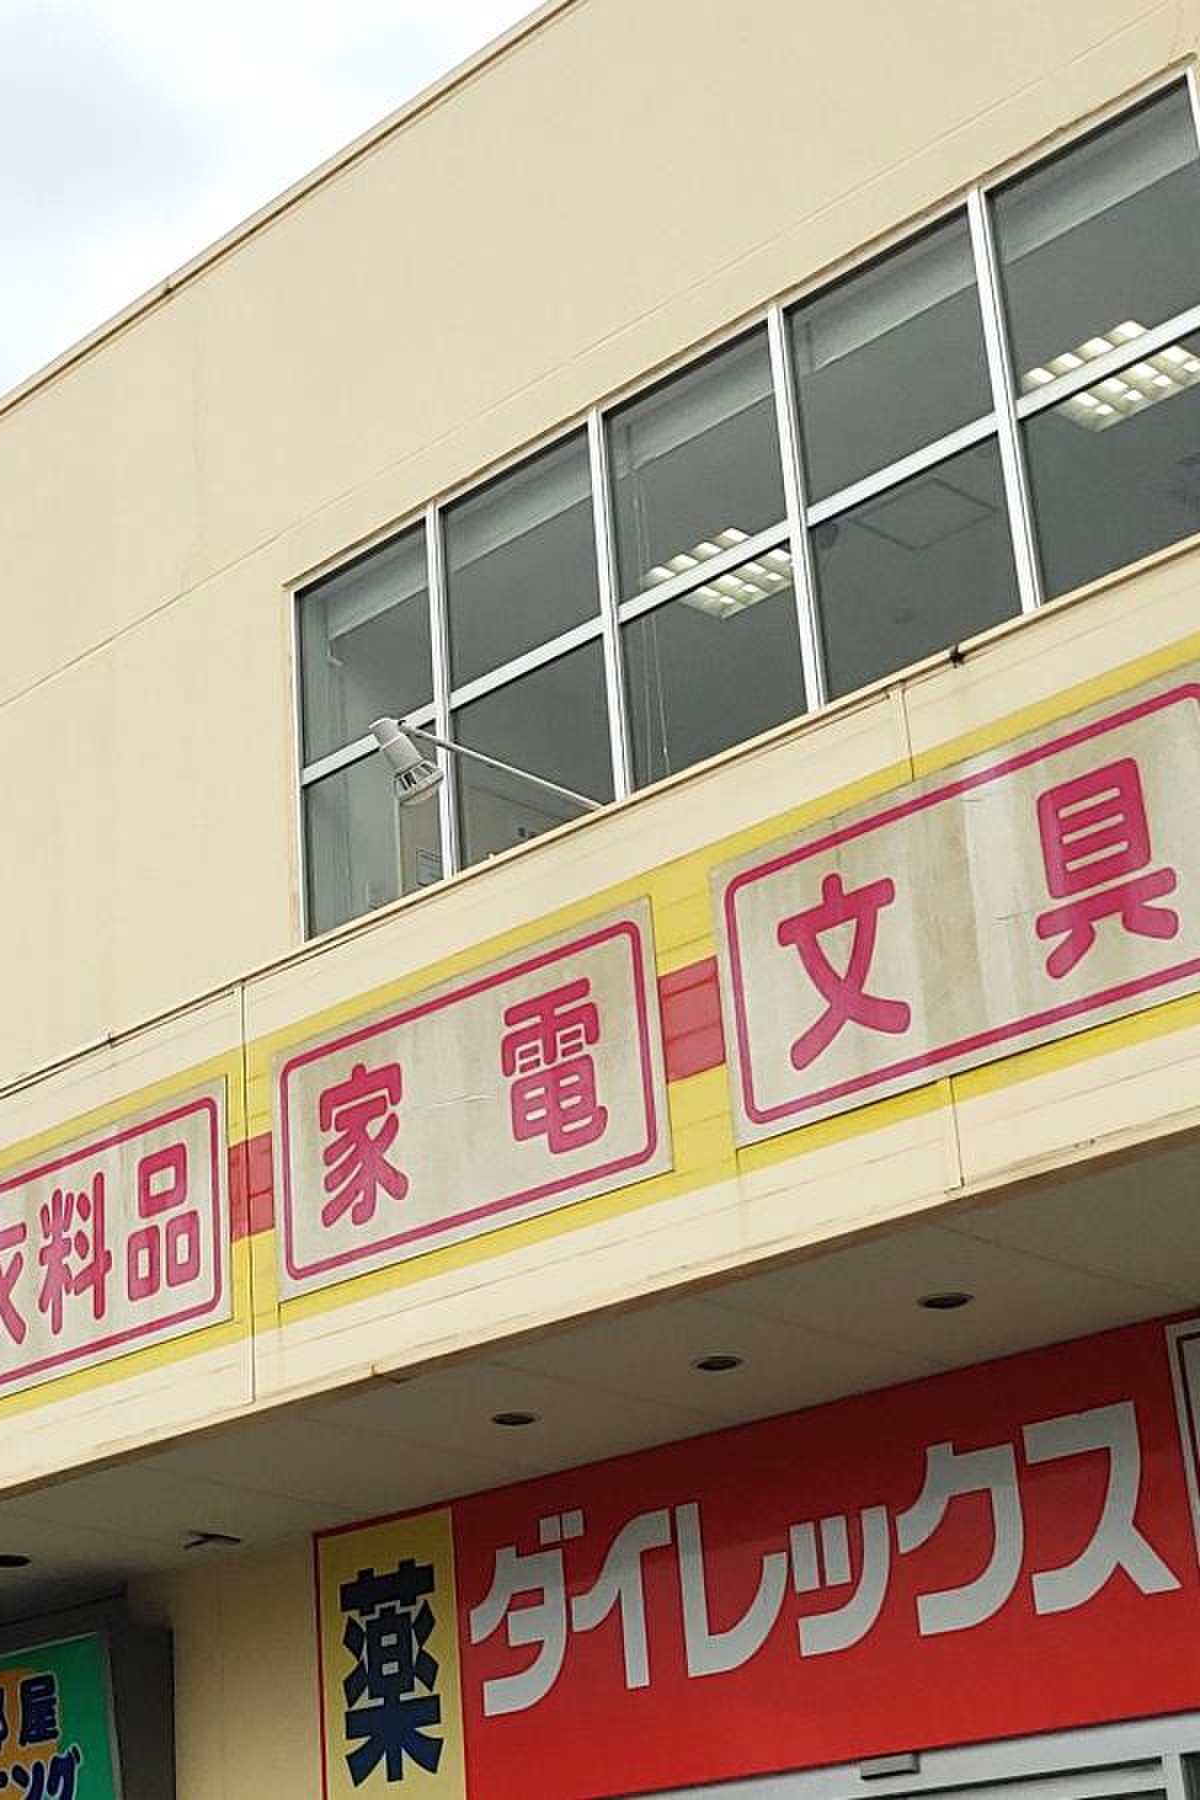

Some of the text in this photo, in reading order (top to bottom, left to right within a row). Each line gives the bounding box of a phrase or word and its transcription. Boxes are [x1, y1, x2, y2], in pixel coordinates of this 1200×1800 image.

[776, 757, 1178, 1071] 文具
[318, 977, 608, 1227] 家電
[339, 1557, 443, 1788] 薬
[468, 1401, 1182, 1718] ダイレックス
